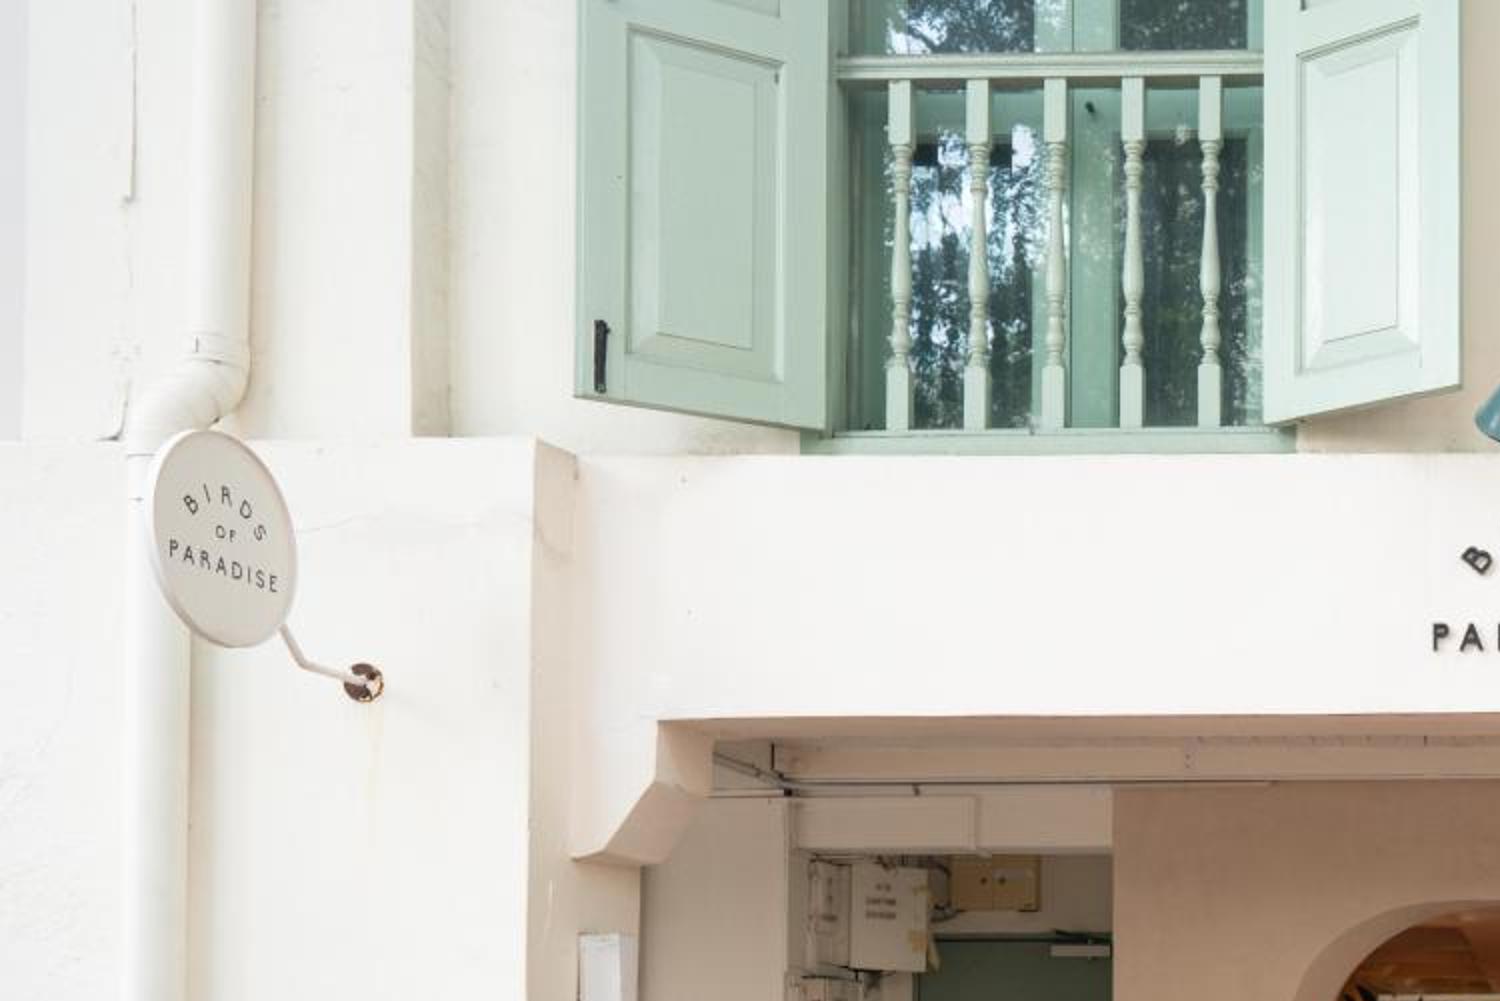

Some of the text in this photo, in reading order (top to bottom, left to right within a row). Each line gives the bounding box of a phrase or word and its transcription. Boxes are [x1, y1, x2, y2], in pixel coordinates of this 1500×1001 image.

[183, 483, 267, 542] BIRDS
[215, 524, 237, 543] OF
[169, 539, 278, 593] PARADISE
